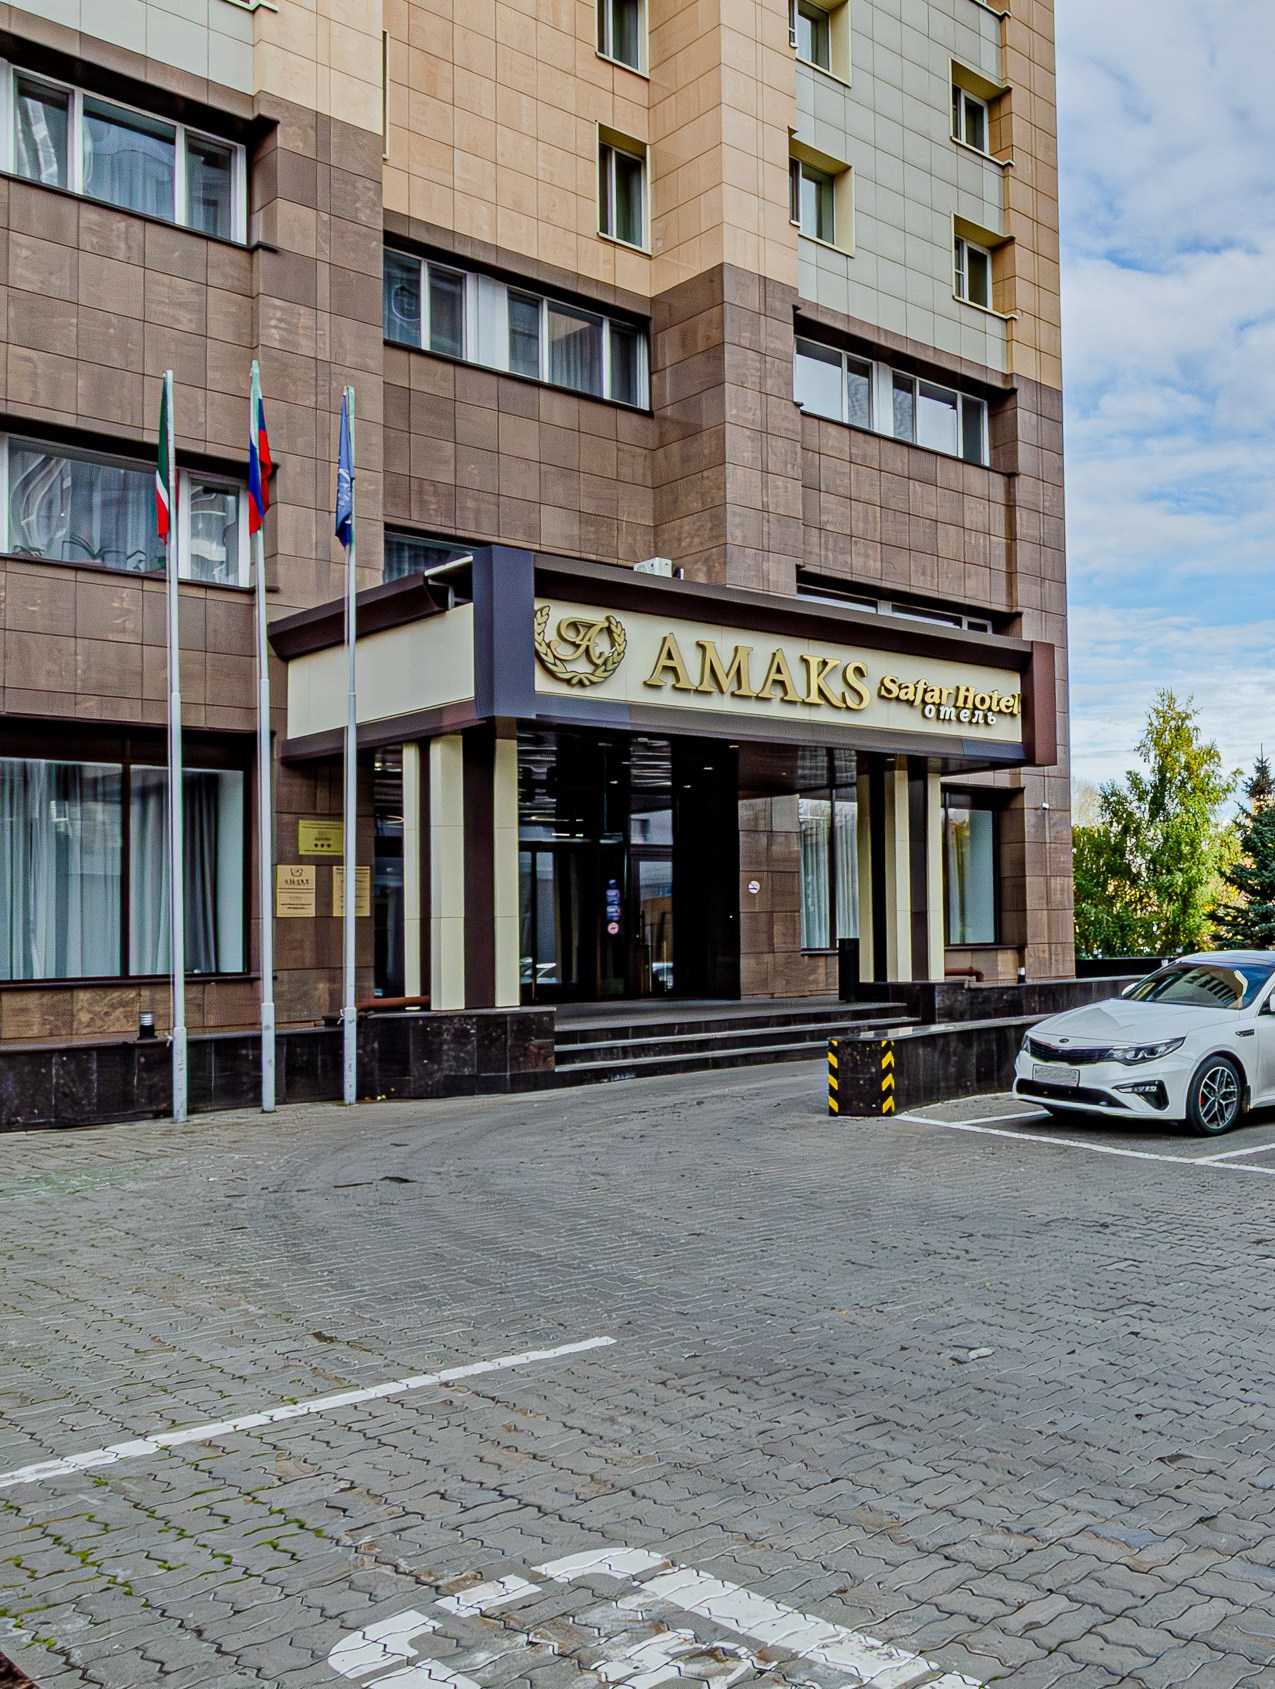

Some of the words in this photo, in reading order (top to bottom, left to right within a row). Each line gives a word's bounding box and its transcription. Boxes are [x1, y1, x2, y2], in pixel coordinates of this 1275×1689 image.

[643, 632, 871, 711] AMAKS
[878, 675, 953, 707] Safar
[956, 685, 1021, 716] Hotel
[924, 703, 996, 725] отель
